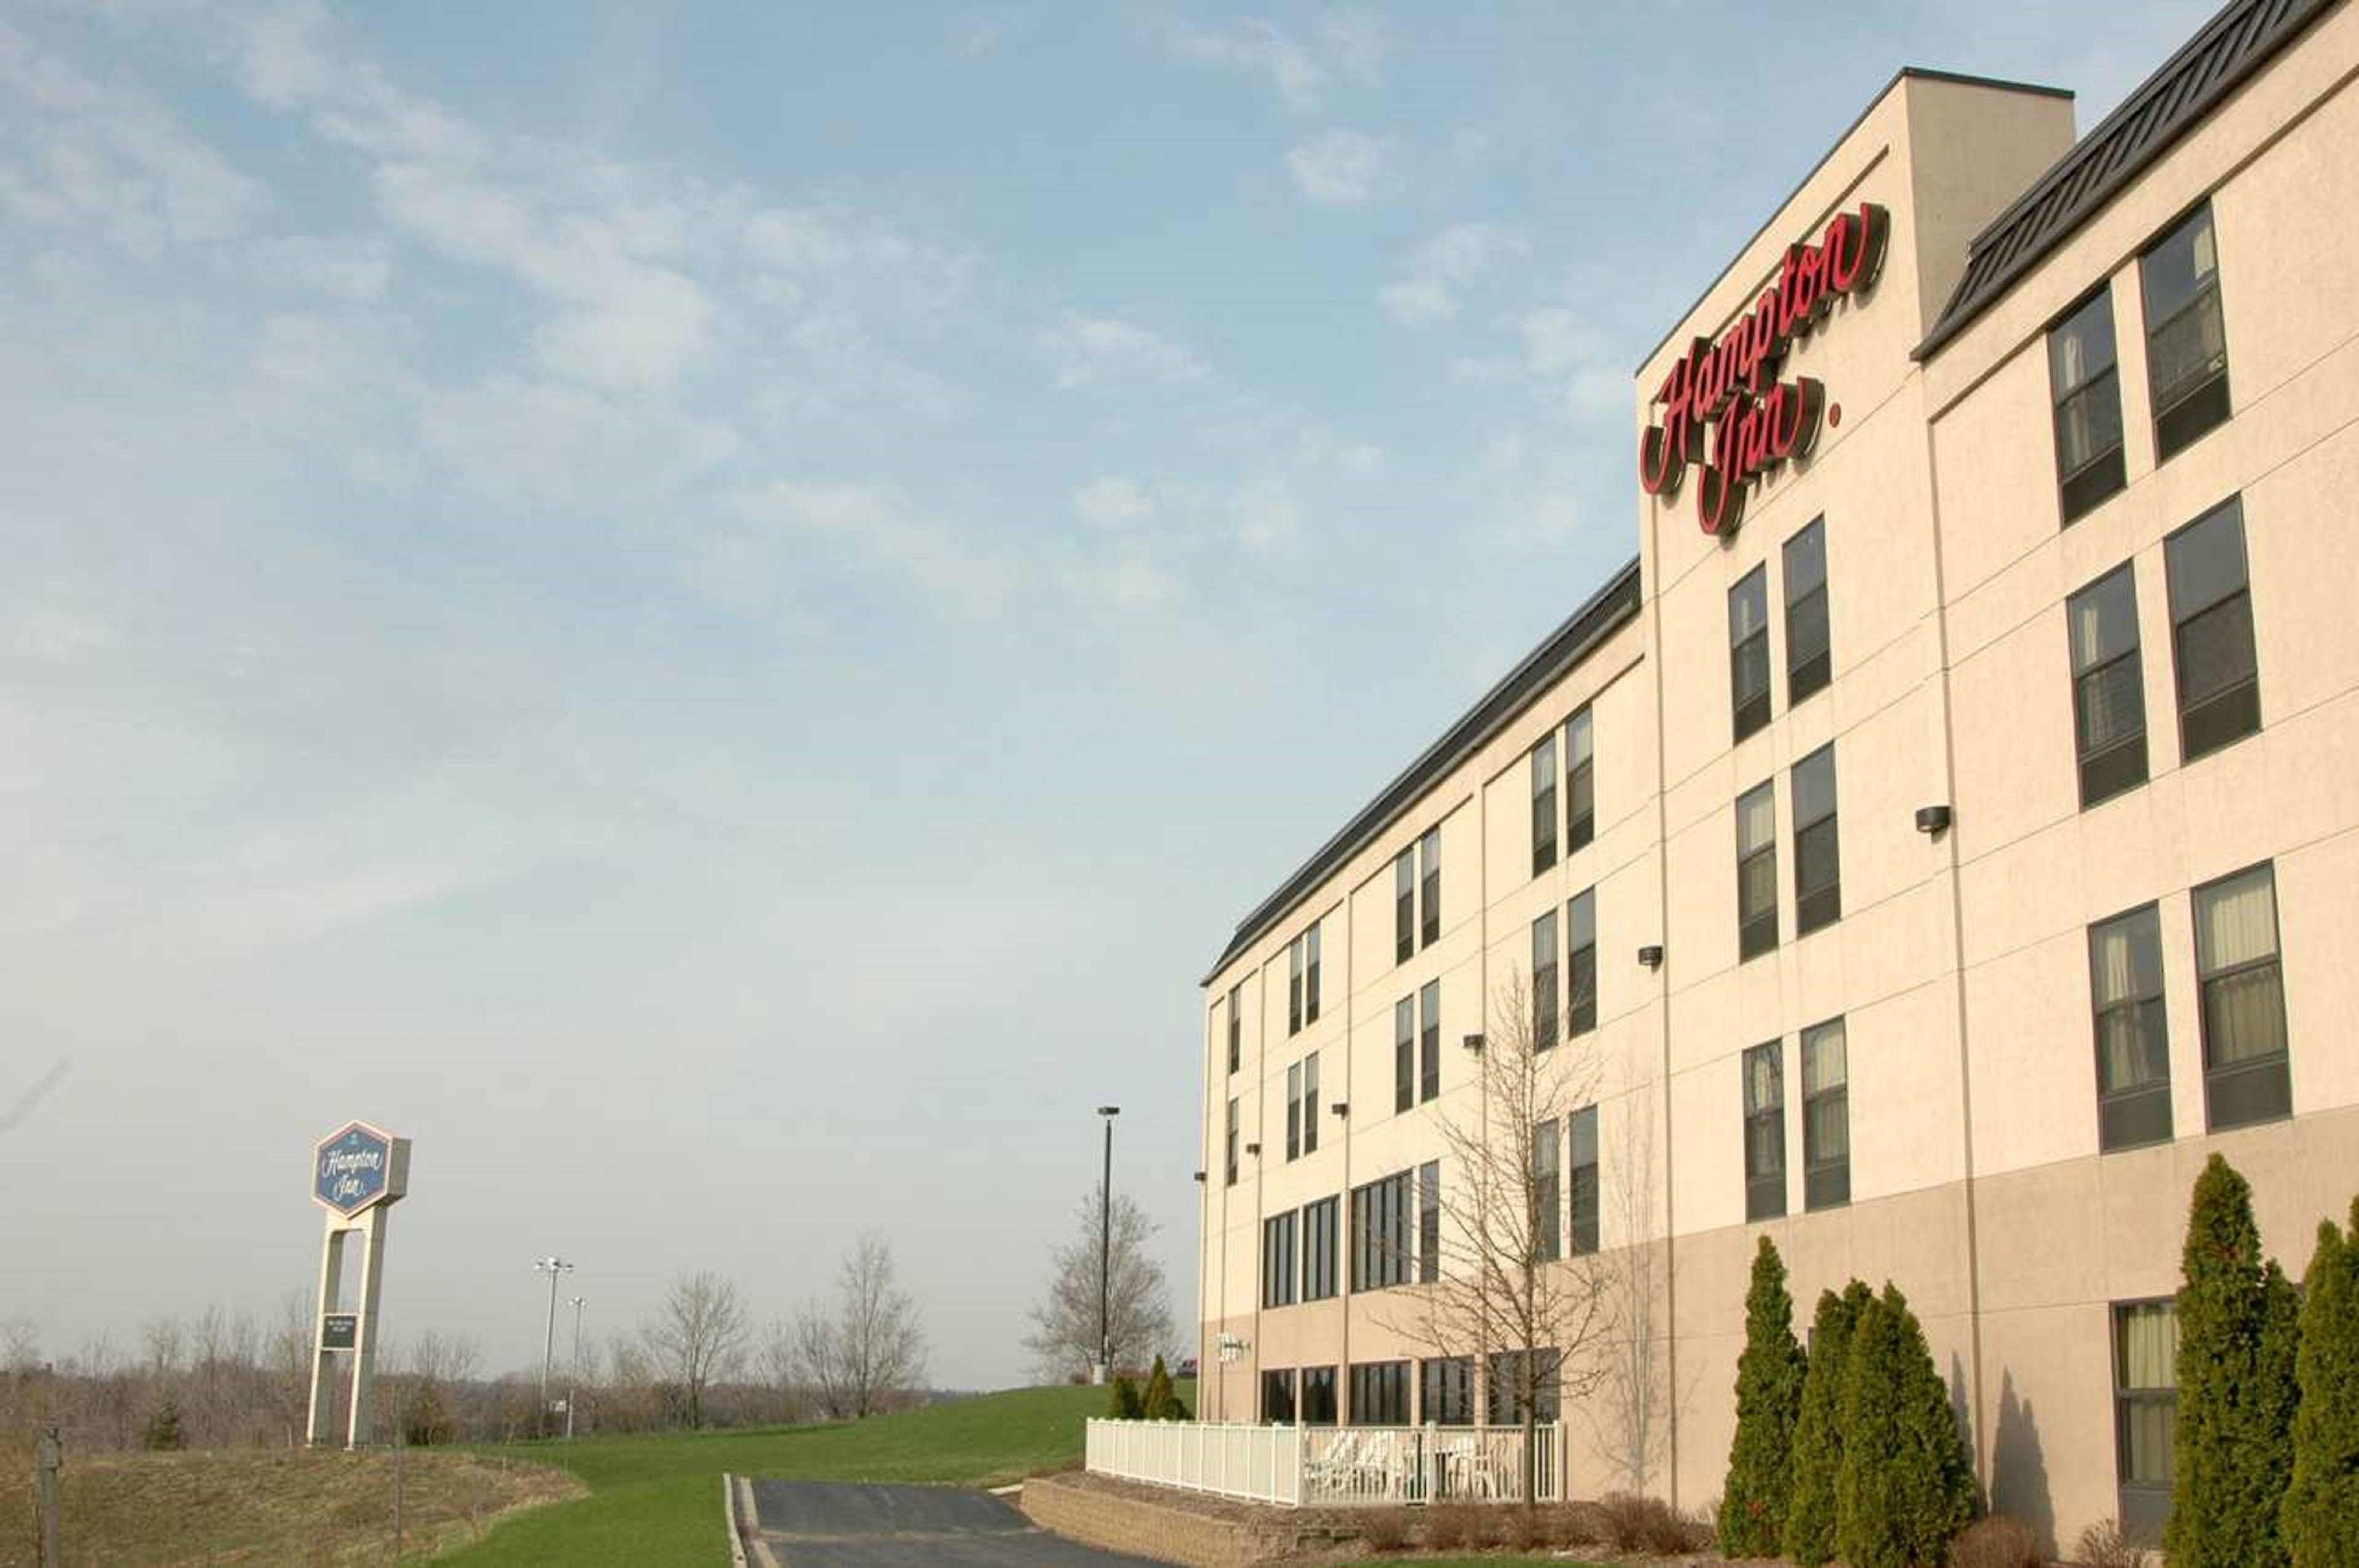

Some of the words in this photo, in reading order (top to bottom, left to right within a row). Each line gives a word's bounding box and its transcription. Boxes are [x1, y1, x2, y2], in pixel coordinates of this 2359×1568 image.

[1640, 202, 1875, 494] Hampton
[1698, 375, 1809, 534] Inn
[322, 1149, 383, 1177] Hampton
[333, 1174, 364, 1201] Inn
